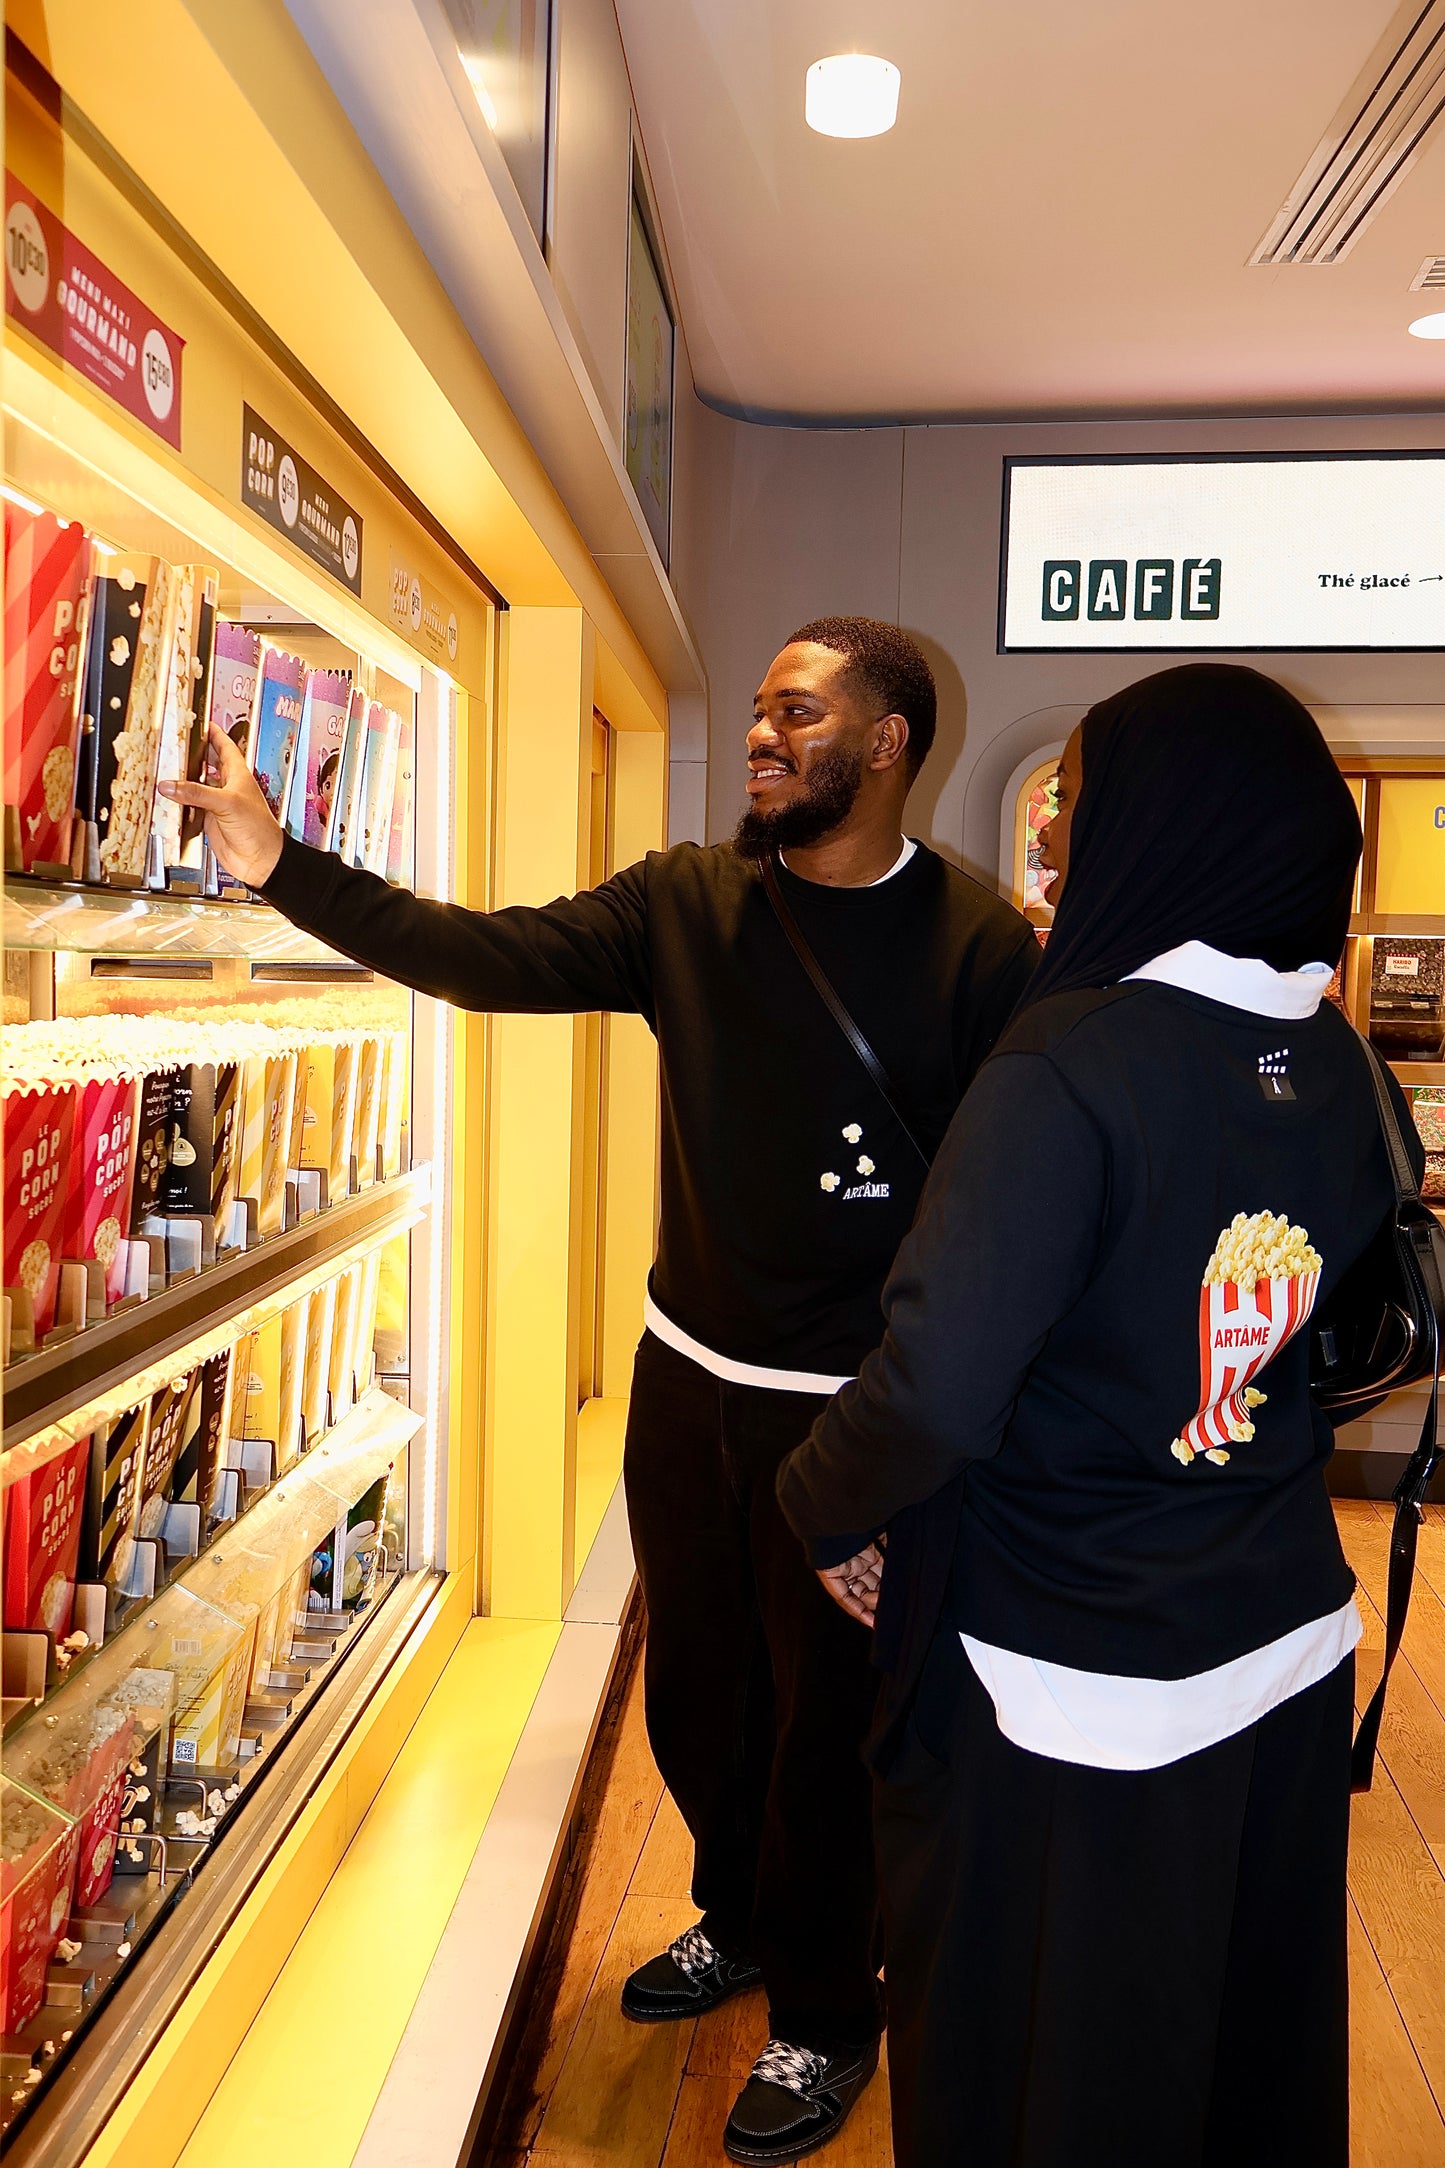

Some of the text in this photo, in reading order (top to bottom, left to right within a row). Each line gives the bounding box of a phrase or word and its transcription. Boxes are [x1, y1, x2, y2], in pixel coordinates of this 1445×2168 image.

[71, 265, 132, 331] MENU MAXI
[57, 279, 137, 368] GOURMAND
[249, 432, 275, 470] POP
[248, 467, 274, 500] CORN
[301, 499, 341, 548] GOURMAND
[393, 567, 409, 595] POP
[1047, 558, 1214, 613] CAFÉ
[1318, 573, 1411, 591] Thé glacé
[38, 1124, 49, 1139] LE
[113, 1111, 123, 1125] LE
[21, 1128, 61, 1178] POP
[97, 1115, 132, 1162] POP
[19, 1161, 60, 1207] CORN
[95, 1145, 130, 1186] CORN
[103, 1169, 126, 1198] SUCRÉ
[28, 1188, 54, 1220] SUCRÉ
[842, 1181, 890, 1200] ARTÂME
[1214, 1323, 1271, 1349] ARTÂME
[149, 1404, 182, 1454] POP
[165, 1403, 174, 1418] LE
[146, 1429, 178, 1473] CORN
[56, 1466, 65, 1481] LE
[43, 1465, 77, 1525] POP
[41, 1495, 75, 1548] CORN
[47, 1523, 71, 1558] SUCRÉ
